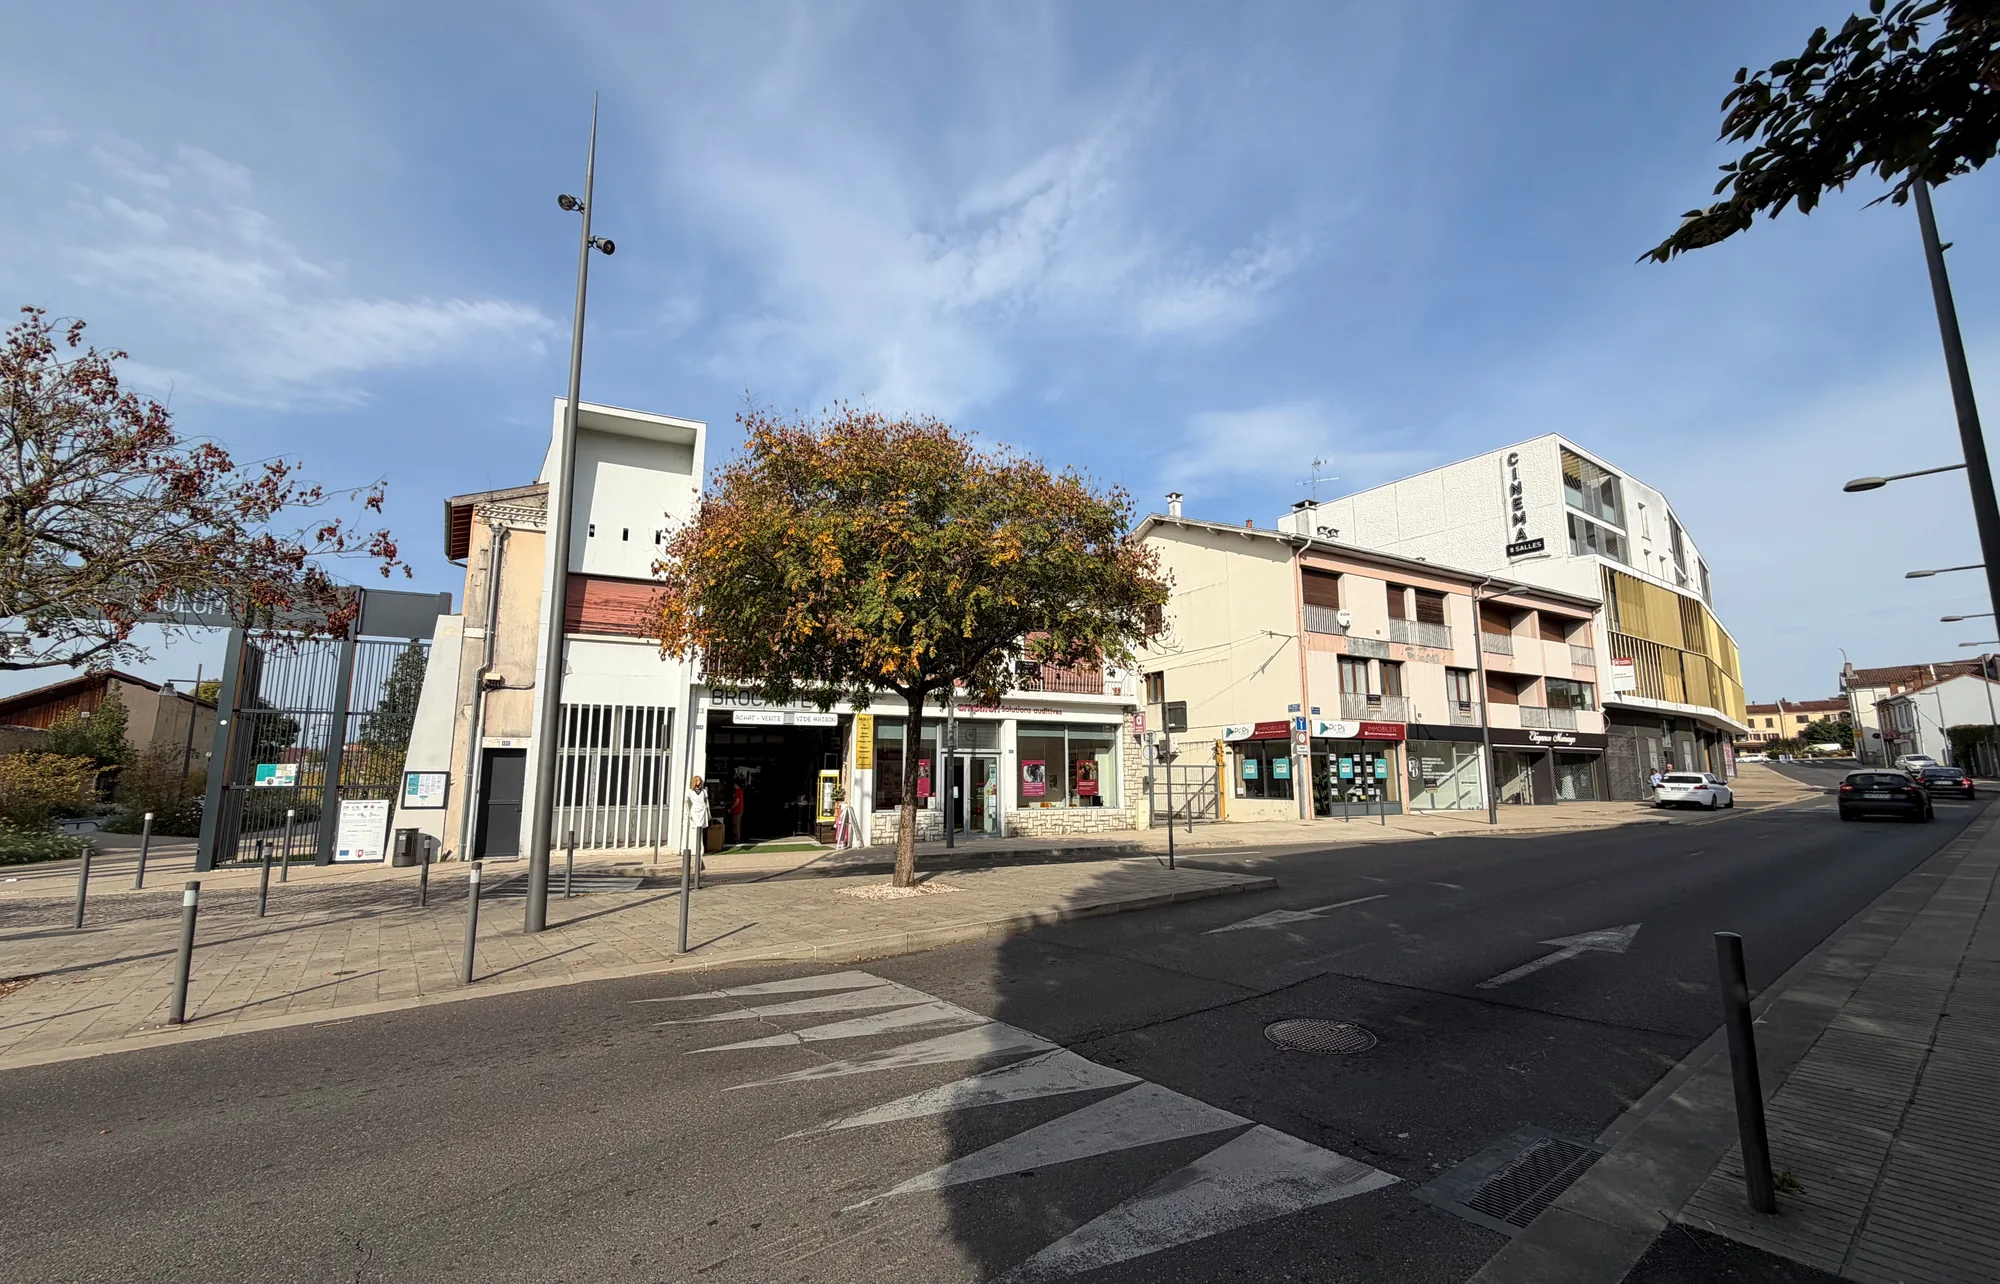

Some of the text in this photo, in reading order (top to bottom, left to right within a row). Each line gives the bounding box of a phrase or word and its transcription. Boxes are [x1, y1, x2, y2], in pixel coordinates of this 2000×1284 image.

[1507, 452, 1527, 542] CINEMA
[1515, 541, 1542, 552] SALLES
[711, 688, 812, 709] BROCTE
[1001, 705, 1032, 713] Solutions
[1034, 707, 1063, 716] auditives
[1553, 732, 1577, 746] Mariage
